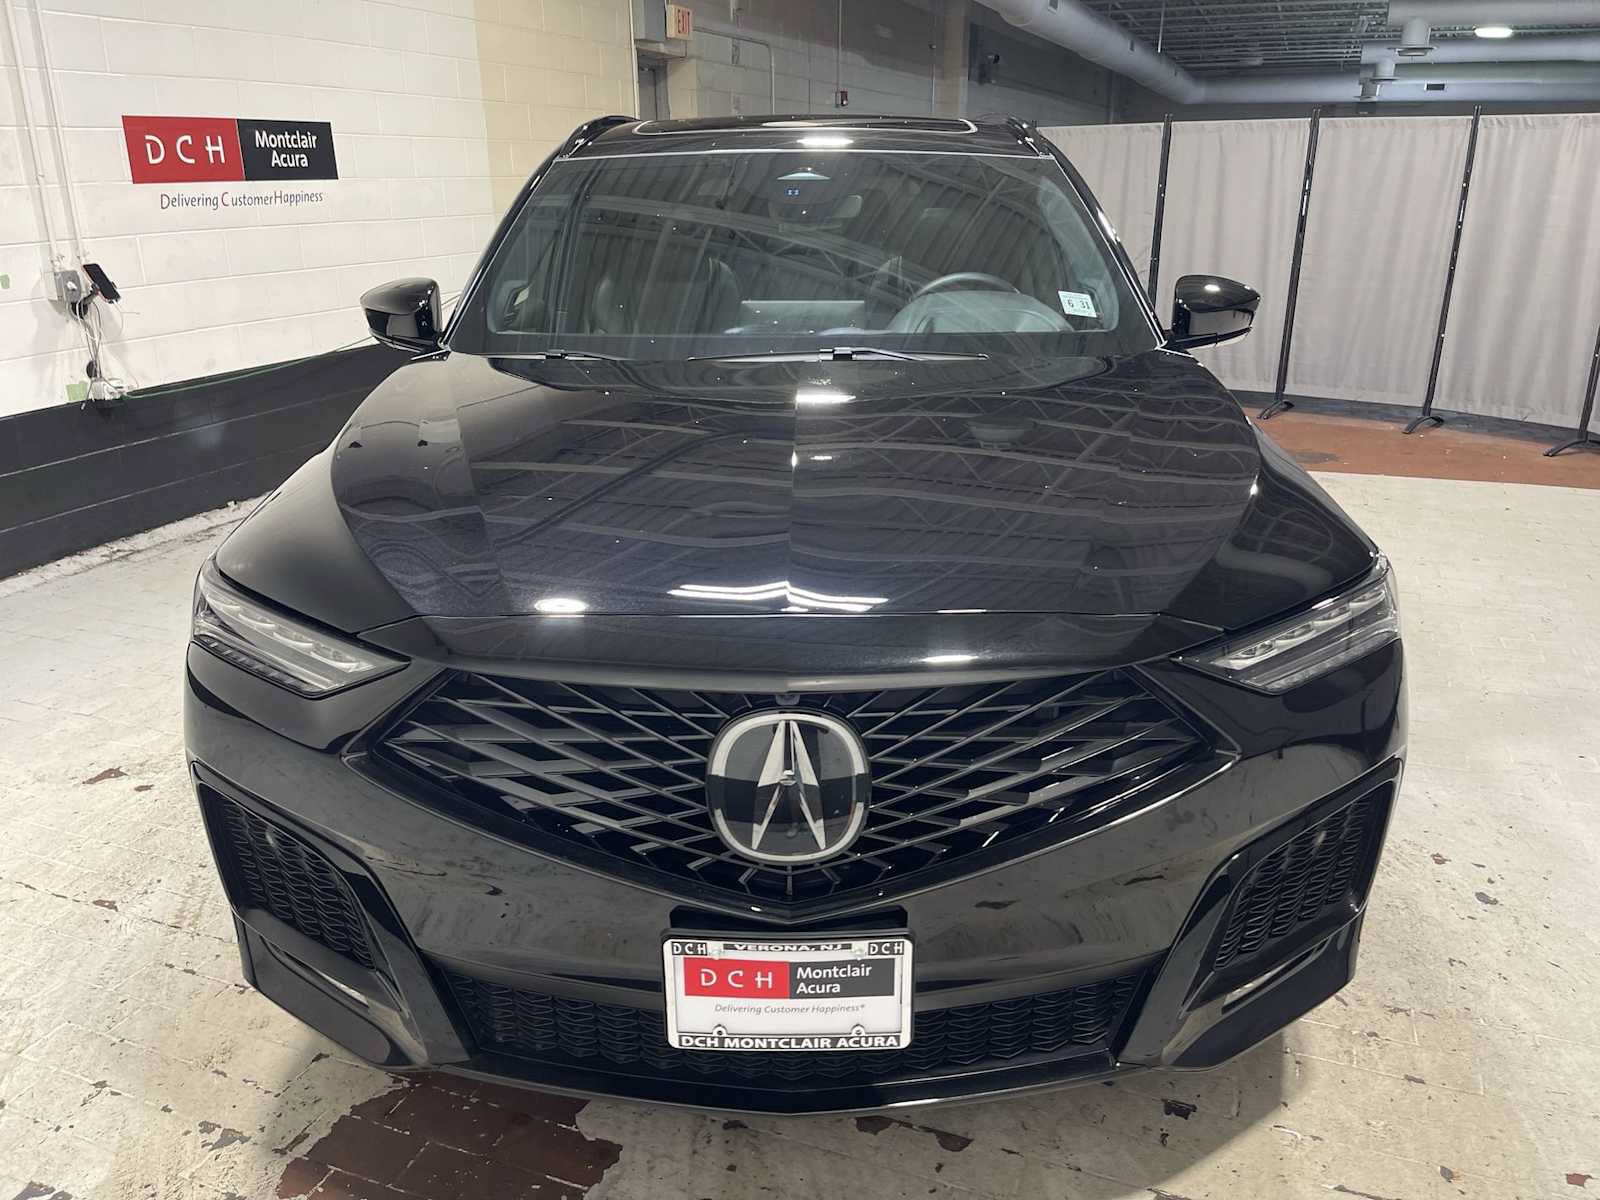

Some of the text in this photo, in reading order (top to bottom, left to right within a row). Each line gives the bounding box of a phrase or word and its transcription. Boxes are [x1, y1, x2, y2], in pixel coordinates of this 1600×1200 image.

[677, 9, 690, 34] EXIT
[255, 129, 318, 149] Montclair
[271, 151, 309, 168] Acura
[160, 190, 323, 211] Delivering Customer Happiness
[734, 943, 842, 952] VERONA, NJ
[797, 964, 872, 979] Montclair
[796, 982, 841, 995] Acura
[714, 1004, 762, 1015] Delivering
[764, 1004, 809, 1014] Customer
[681, 1035, 898, 1049] DCH MONTCLAIR ACURA
